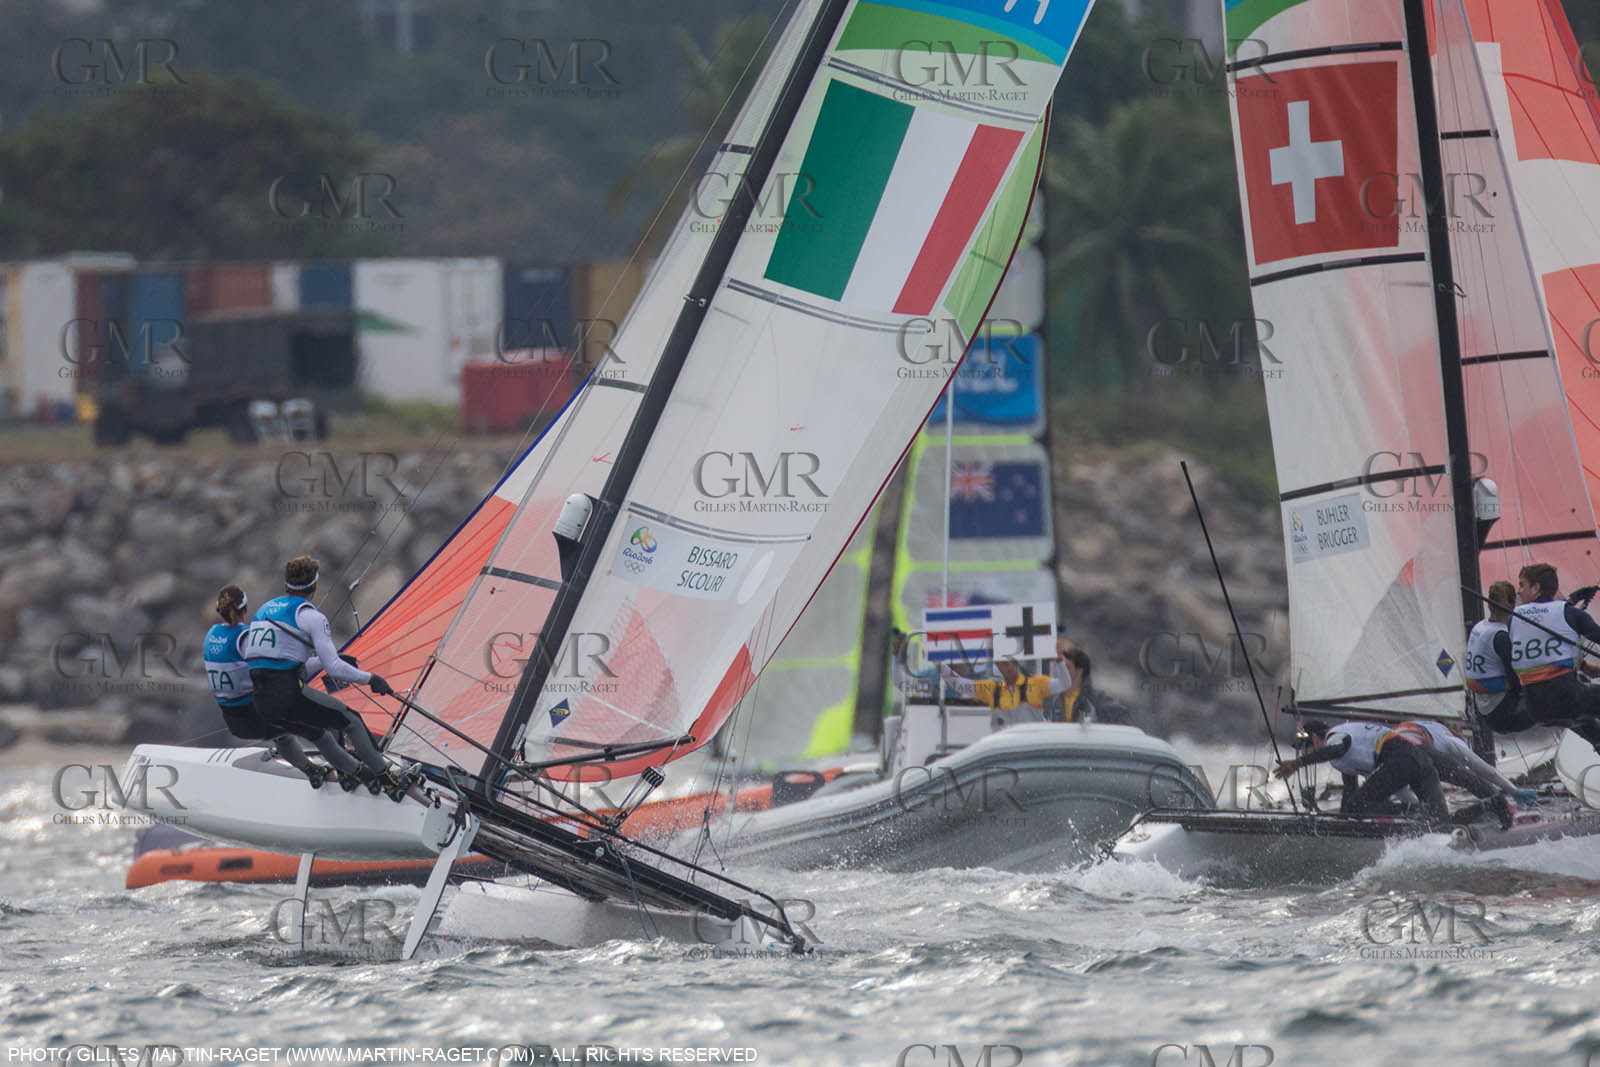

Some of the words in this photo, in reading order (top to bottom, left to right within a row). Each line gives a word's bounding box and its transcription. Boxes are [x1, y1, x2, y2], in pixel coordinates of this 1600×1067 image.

[1316, 504, 1350, 526] BUHLER
[1318, 526, 1359, 550] BRUGGER
[688, 546, 738, 569] BISSARO
[677, 570, 726, 592] SICOURI
[251, 627, 276, 648] TA
[1511, 637, 1562, 662] GBR
[1466, 651, 1486, 673] BR
[208, 669, 234, 690] TA
